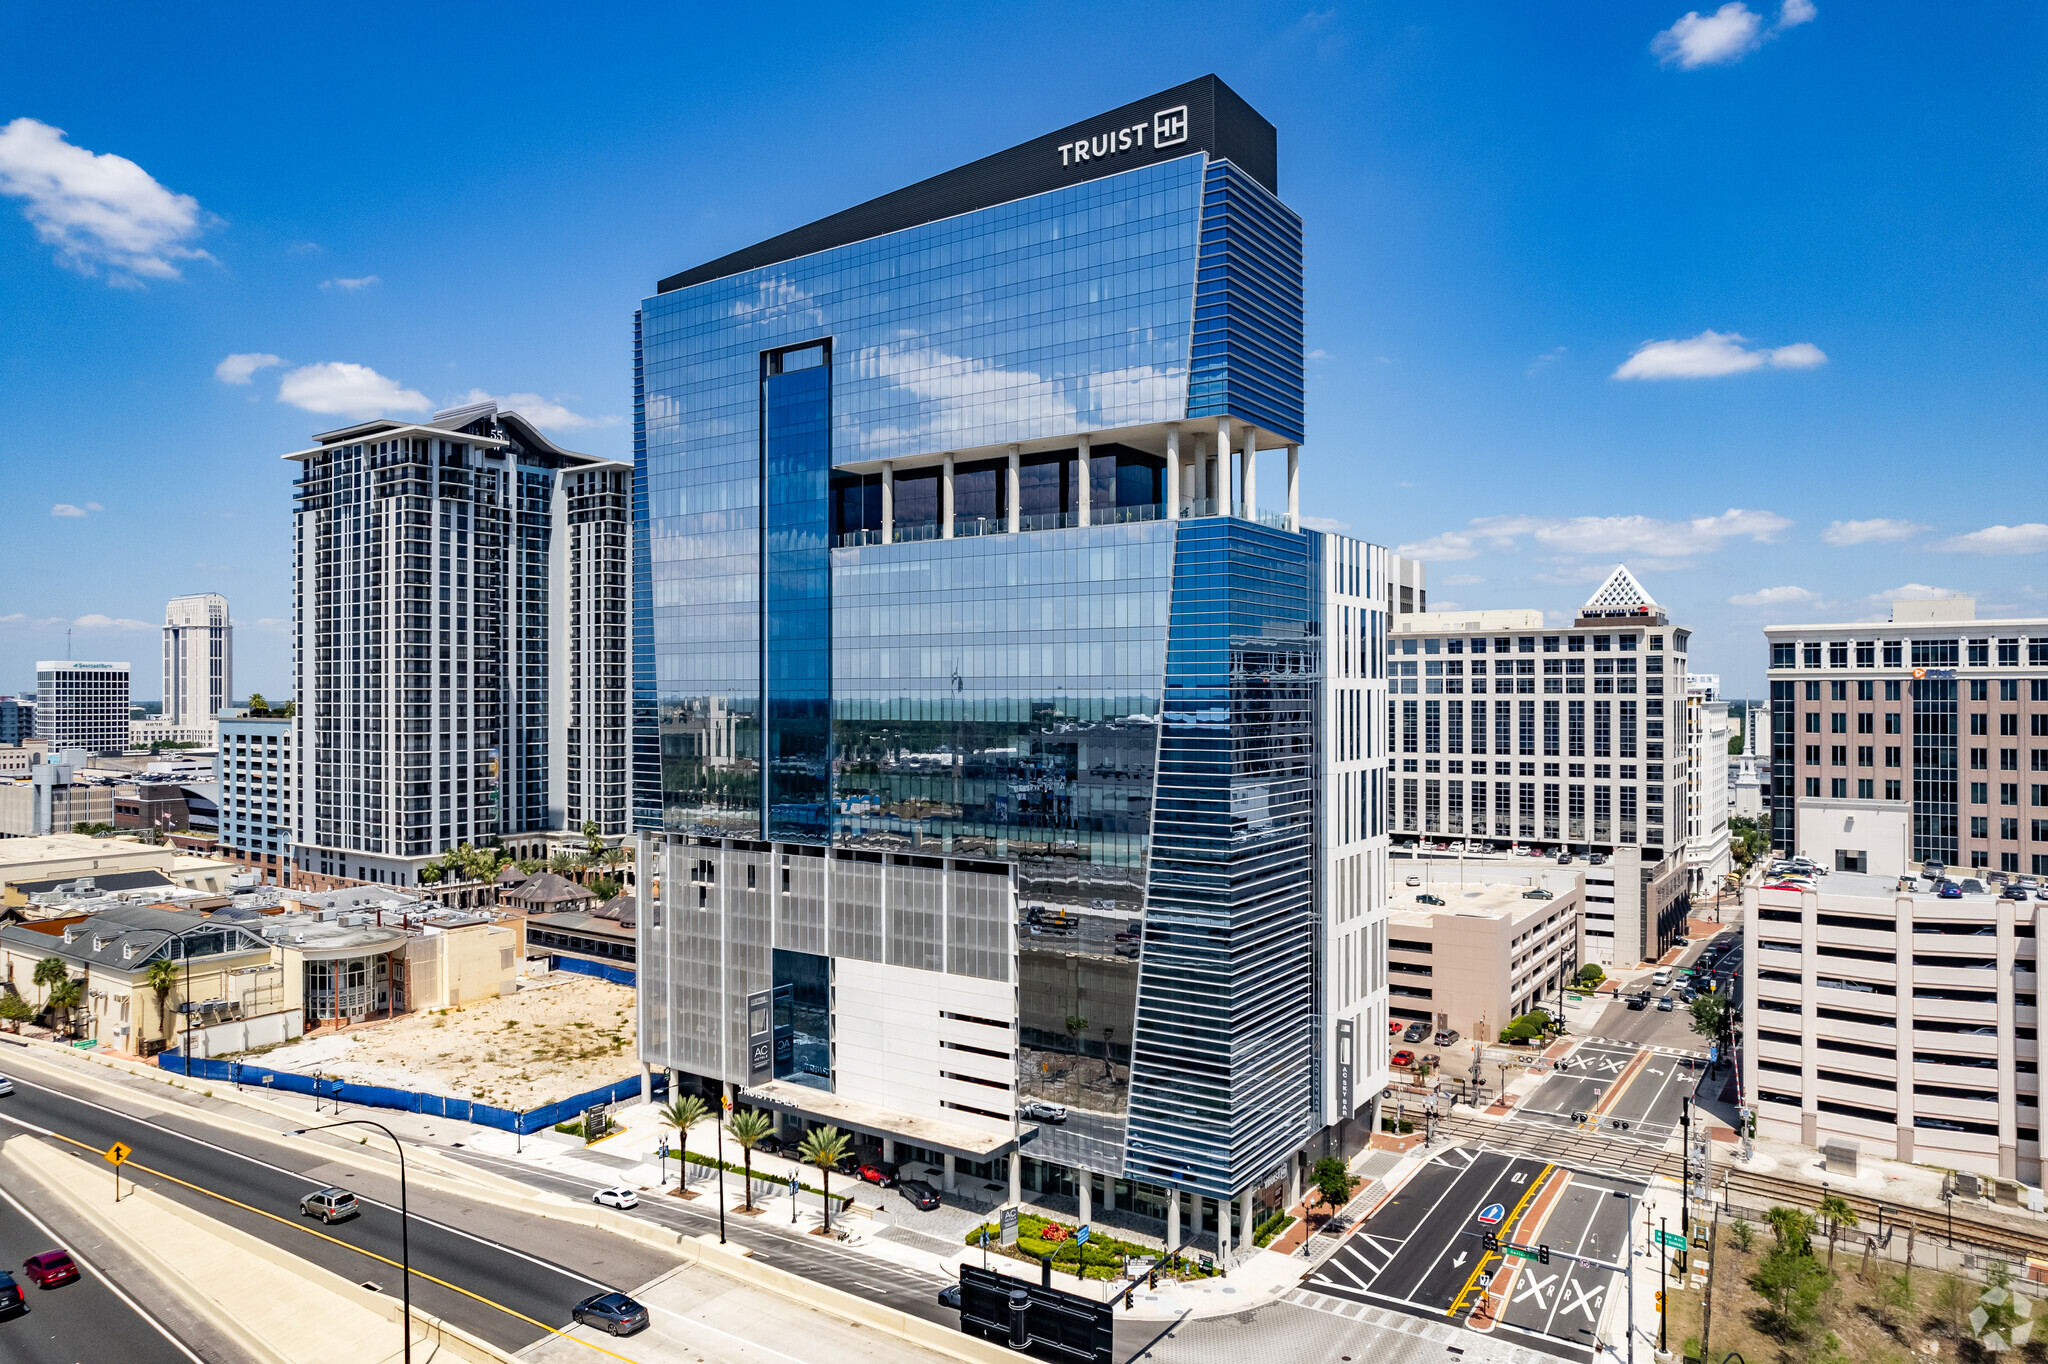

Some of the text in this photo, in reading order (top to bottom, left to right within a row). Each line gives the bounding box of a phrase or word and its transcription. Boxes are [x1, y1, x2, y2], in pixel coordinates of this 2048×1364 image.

[1058, 122, 1149, 166] TRUIST
[1926, 668, 1957, 678] PNC
[754, 1045, 768, 1058] AC
[739, 1085, 799, 1109] TRUIST PLAZA
[1005, 1209, 1017, 1219] AC
